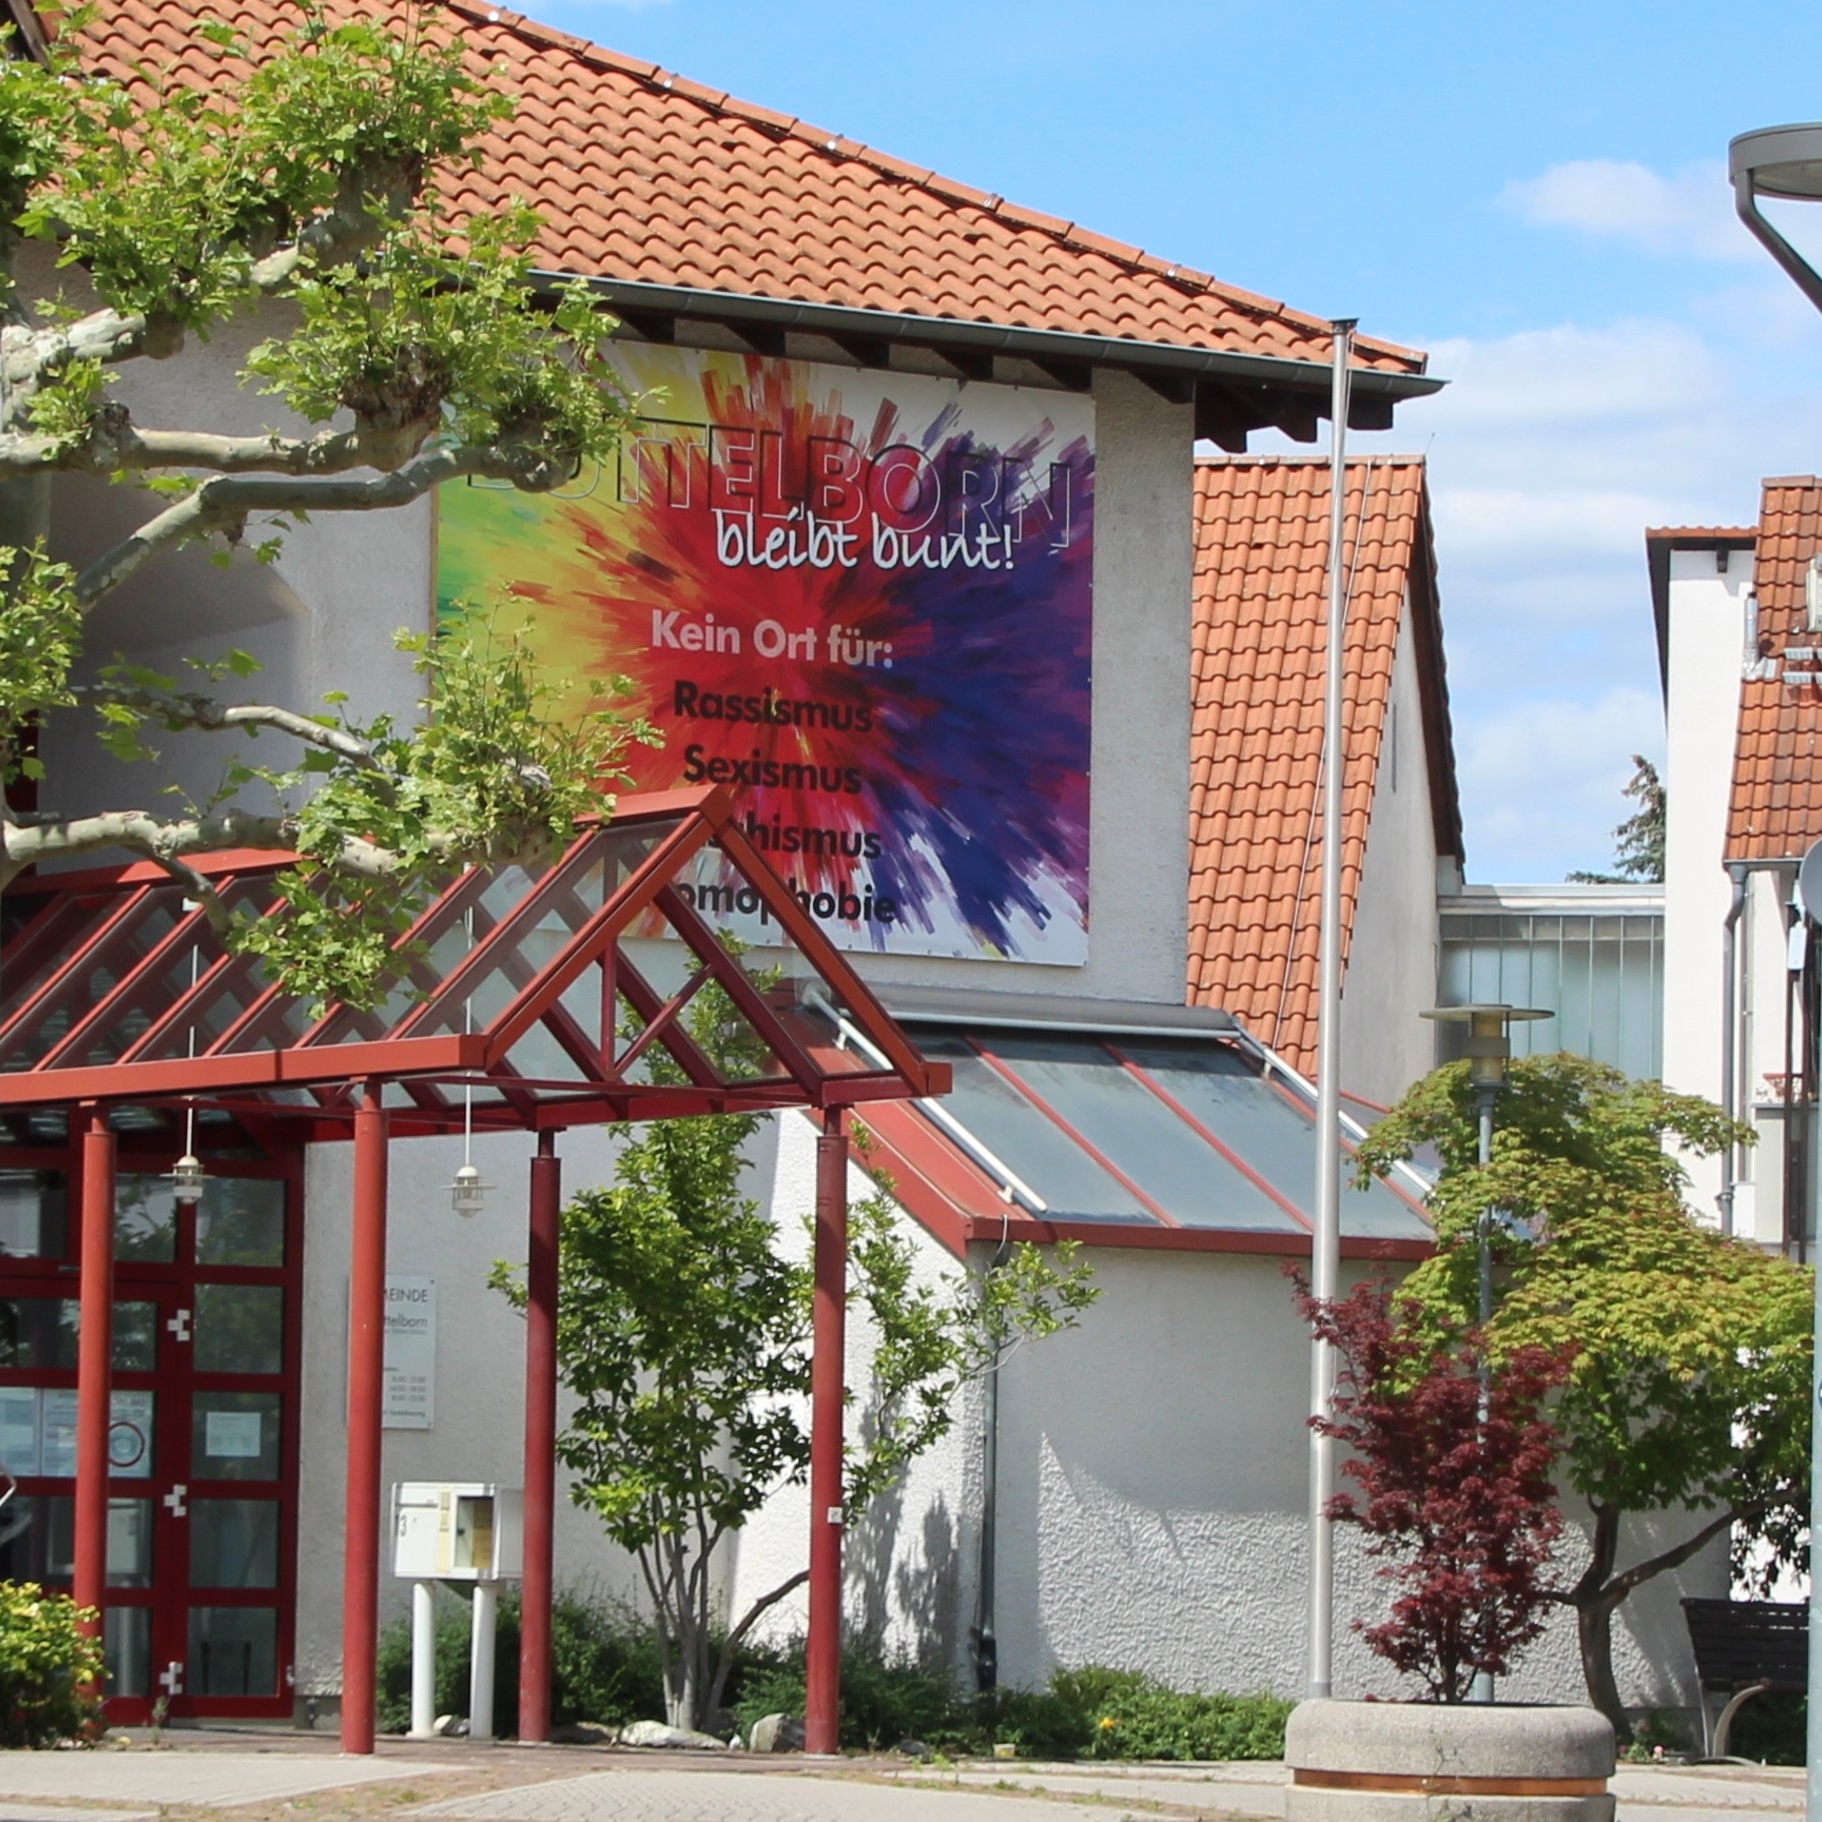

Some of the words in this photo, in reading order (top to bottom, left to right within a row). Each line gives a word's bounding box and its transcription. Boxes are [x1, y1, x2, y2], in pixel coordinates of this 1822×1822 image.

[468, 408, 1071, 549] TTELBORN
[716, 508, 857, 569] bleibt
[872, 512, 1015, 569] bunt!
[651, 609, 740, 654] Kein
[753, 618, 817, 661] Ort
[827, 624, 893, 668] für:
[674, 679, 873, 732] Rassismus
[682, 743, 862, 794] Sexismus
[705, 811, 882, 860] hismus
[676, 878, 897, 925] omoobie
[383, 1287, 428, 1303] EINDE
